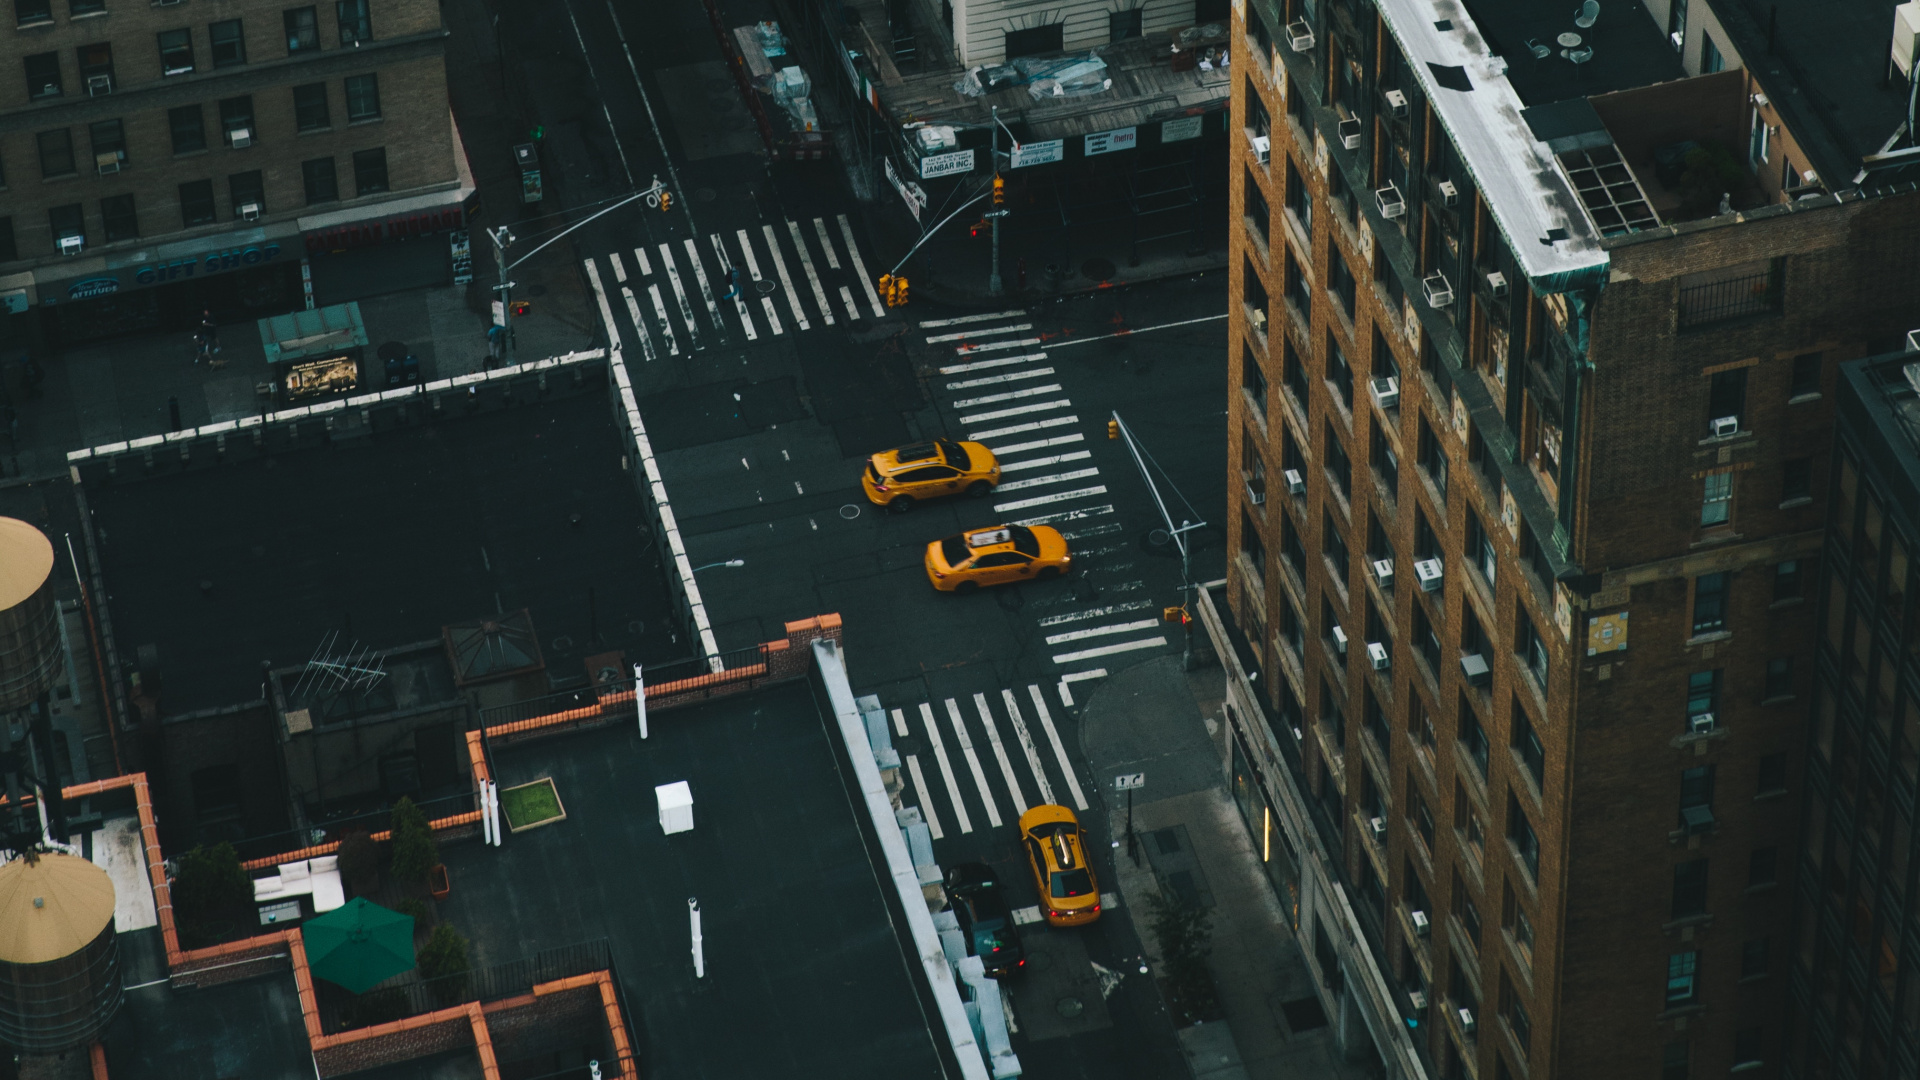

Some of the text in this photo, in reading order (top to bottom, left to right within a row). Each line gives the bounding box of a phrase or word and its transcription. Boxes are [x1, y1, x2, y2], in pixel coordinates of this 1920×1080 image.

[925, 162, 955, 174] JANBAR
[956, 159, 972, 168] INC.
[136, 244, 281, 285] GIFT SHOP
[71, 285, 118, 299] ATTITUDE
